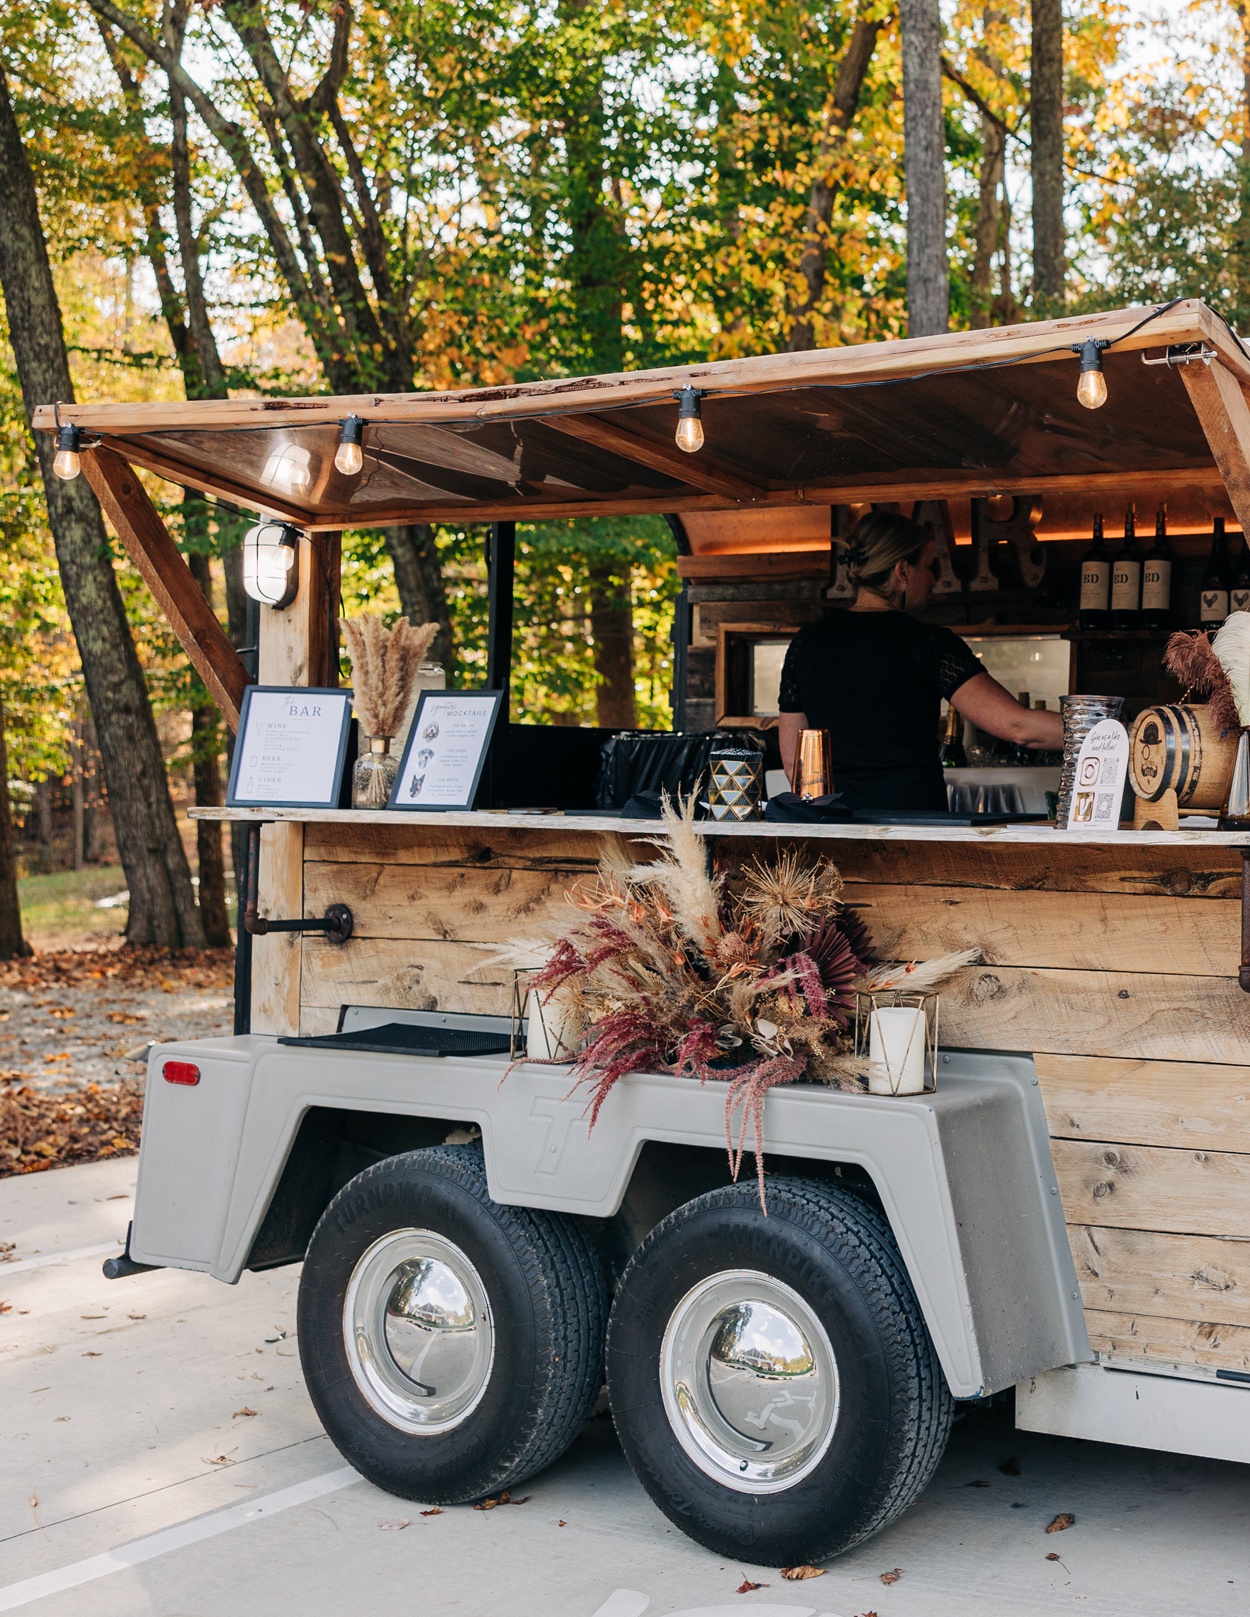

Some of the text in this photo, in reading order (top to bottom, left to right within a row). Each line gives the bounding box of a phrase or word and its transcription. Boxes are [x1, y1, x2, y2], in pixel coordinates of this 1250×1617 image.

[289, 705, 322, 718] BAR
[446, 710, 488, 718] MOCKTAILS
[335, 1181, 433, 1233] TURNPIKE
[717, 1223, 842, 1304] TURNPIKE
